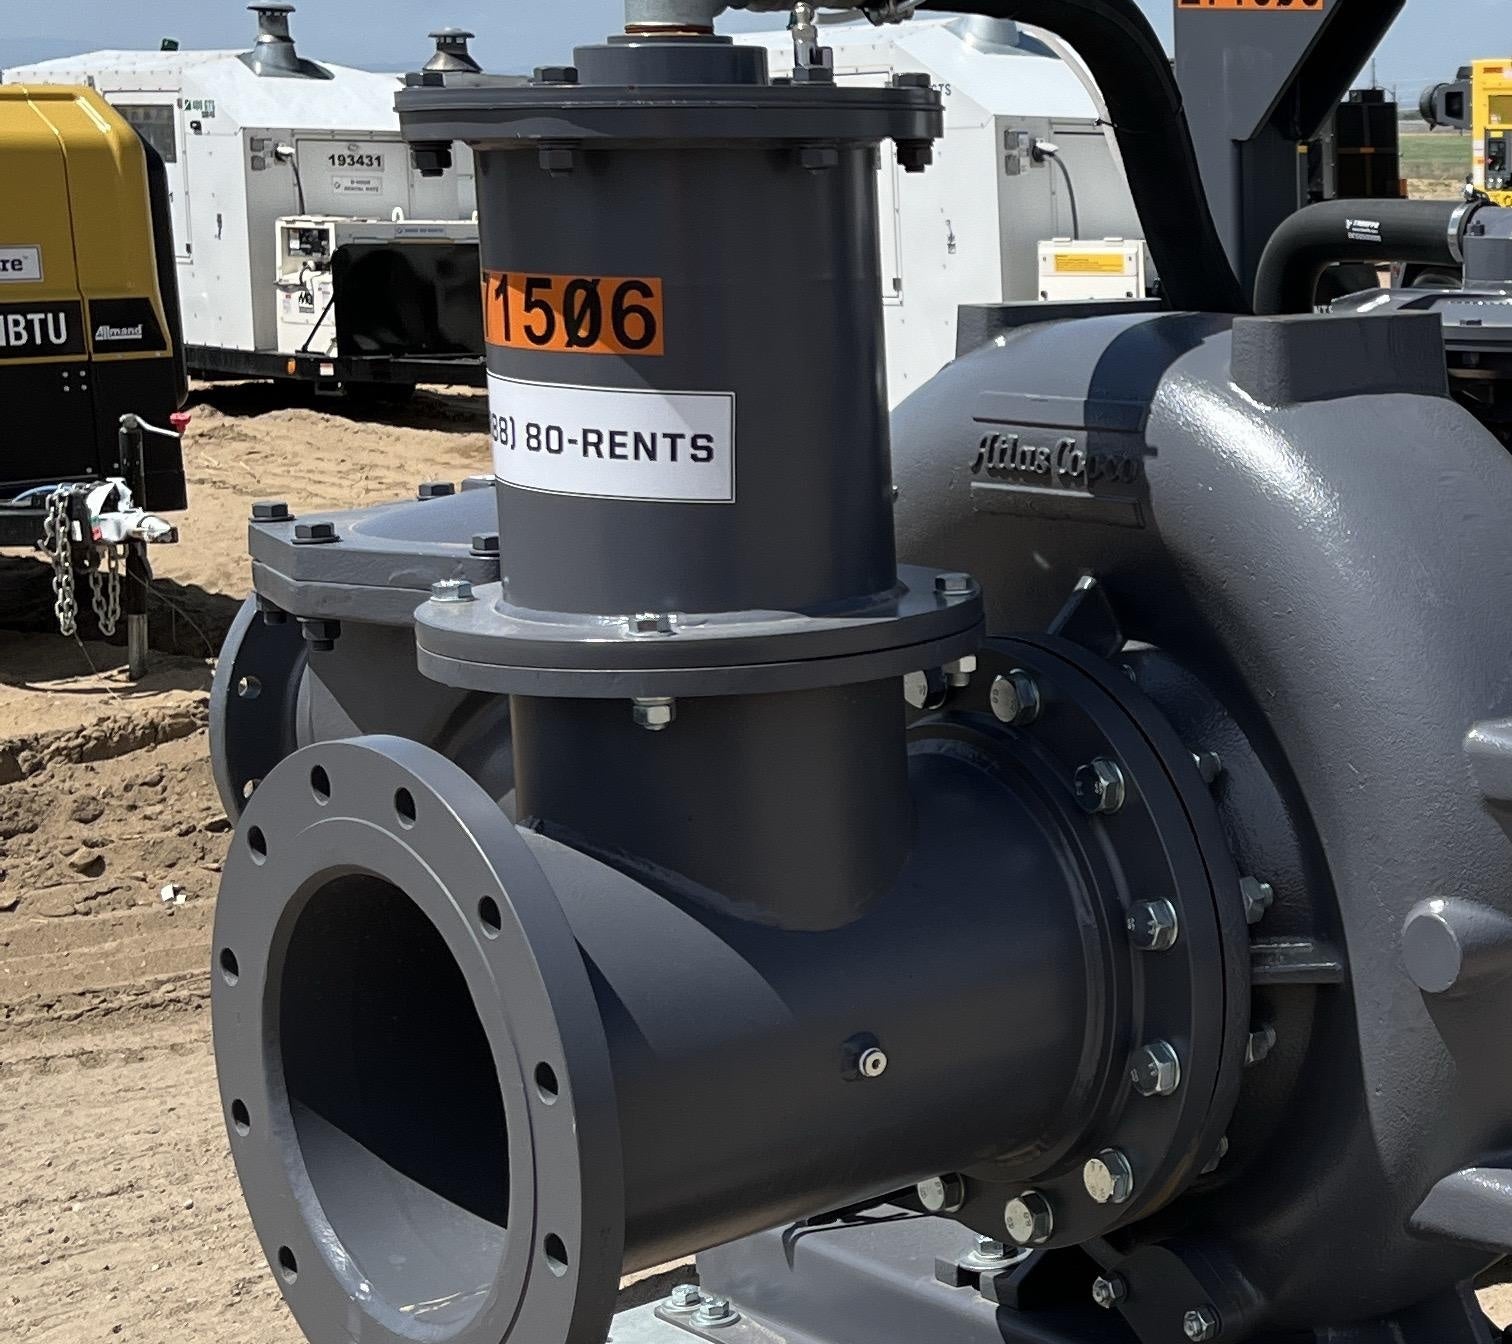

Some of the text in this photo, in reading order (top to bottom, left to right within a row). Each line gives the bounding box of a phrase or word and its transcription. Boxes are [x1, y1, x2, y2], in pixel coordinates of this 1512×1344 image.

[328, 154, 382, 167] 193431
[0, 312, 67, 347] BTU
[95, 324, 143, 339] Allmand
[525, 422, 714, 462] 80-RENTS
[970, 432, 1050, 474] Atlas
